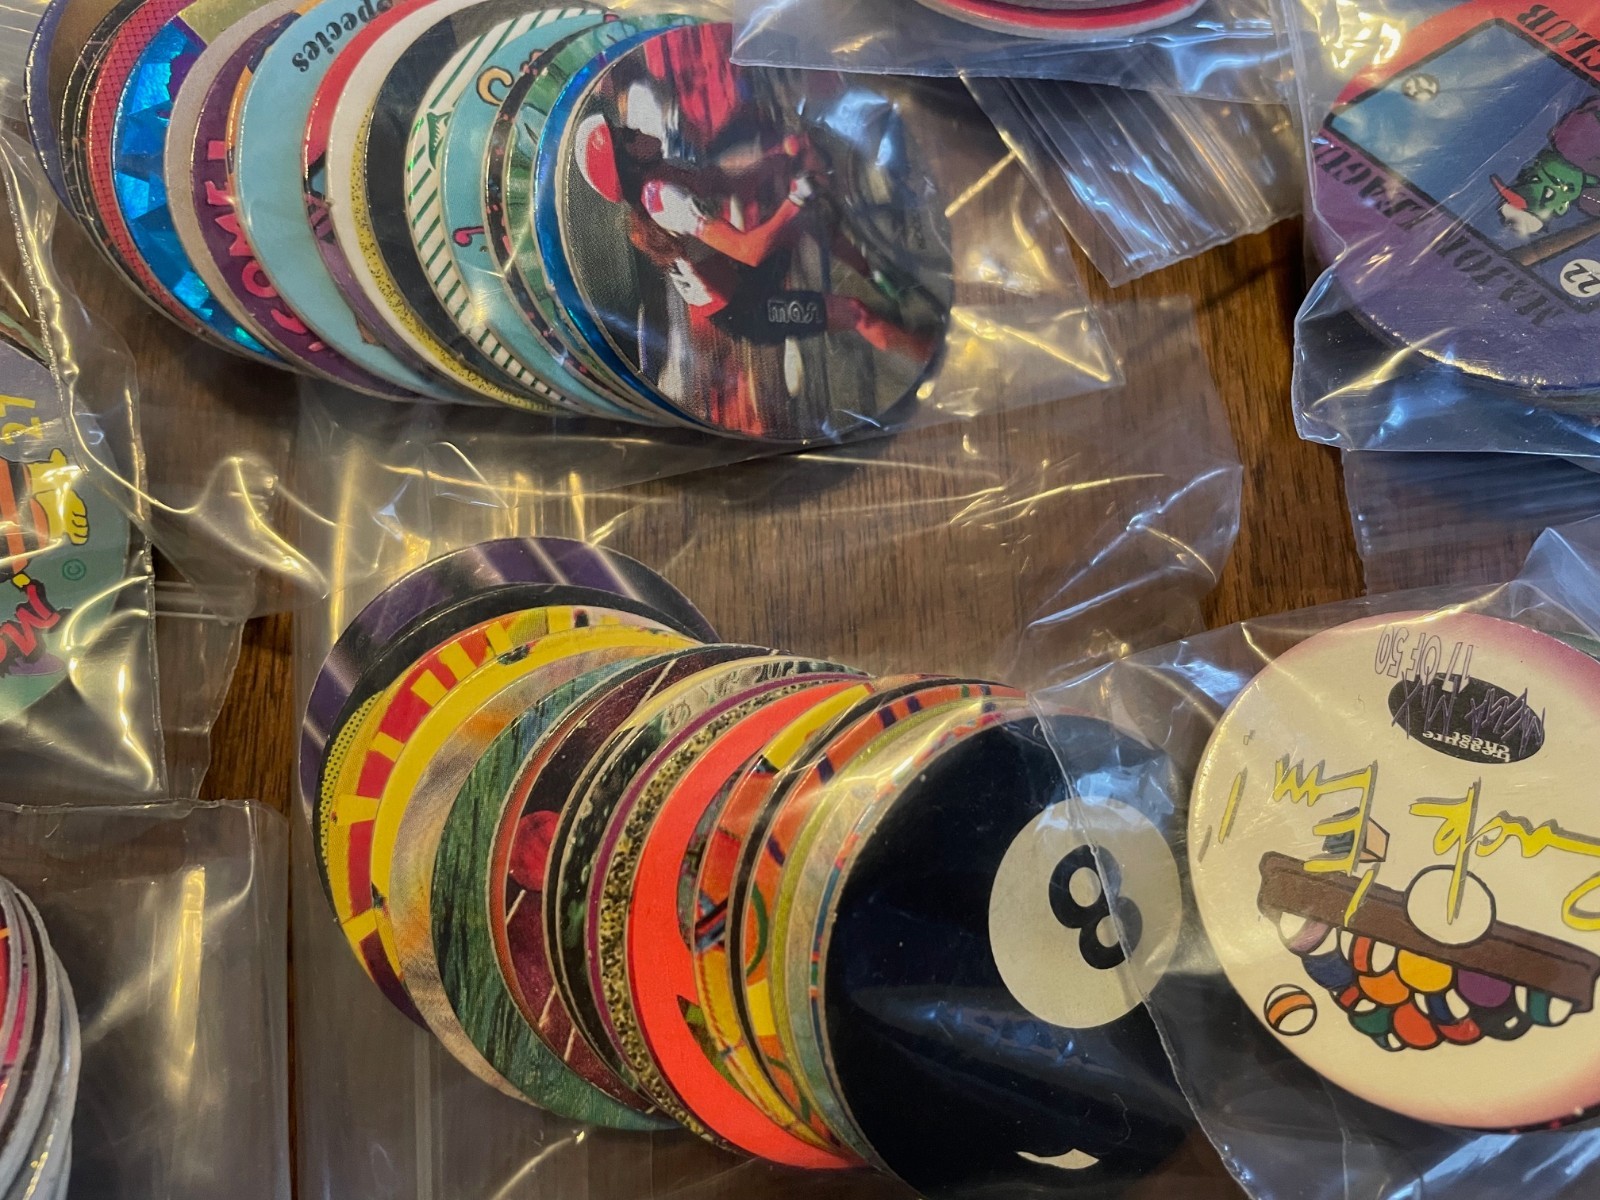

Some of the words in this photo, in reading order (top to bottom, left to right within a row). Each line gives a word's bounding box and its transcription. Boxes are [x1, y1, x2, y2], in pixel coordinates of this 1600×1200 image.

[1517, 4, 1600, 72] CLUB
[1563, 262, 1600, 294] 22
[1374, 625, 1410, 679] 50
[1405, 632, 1442, 686] OF
[1442, 641, 1473, 694] 17
[1422, 730, 1511, 763] treasure
[1049, 843, 1143, 970] 8
